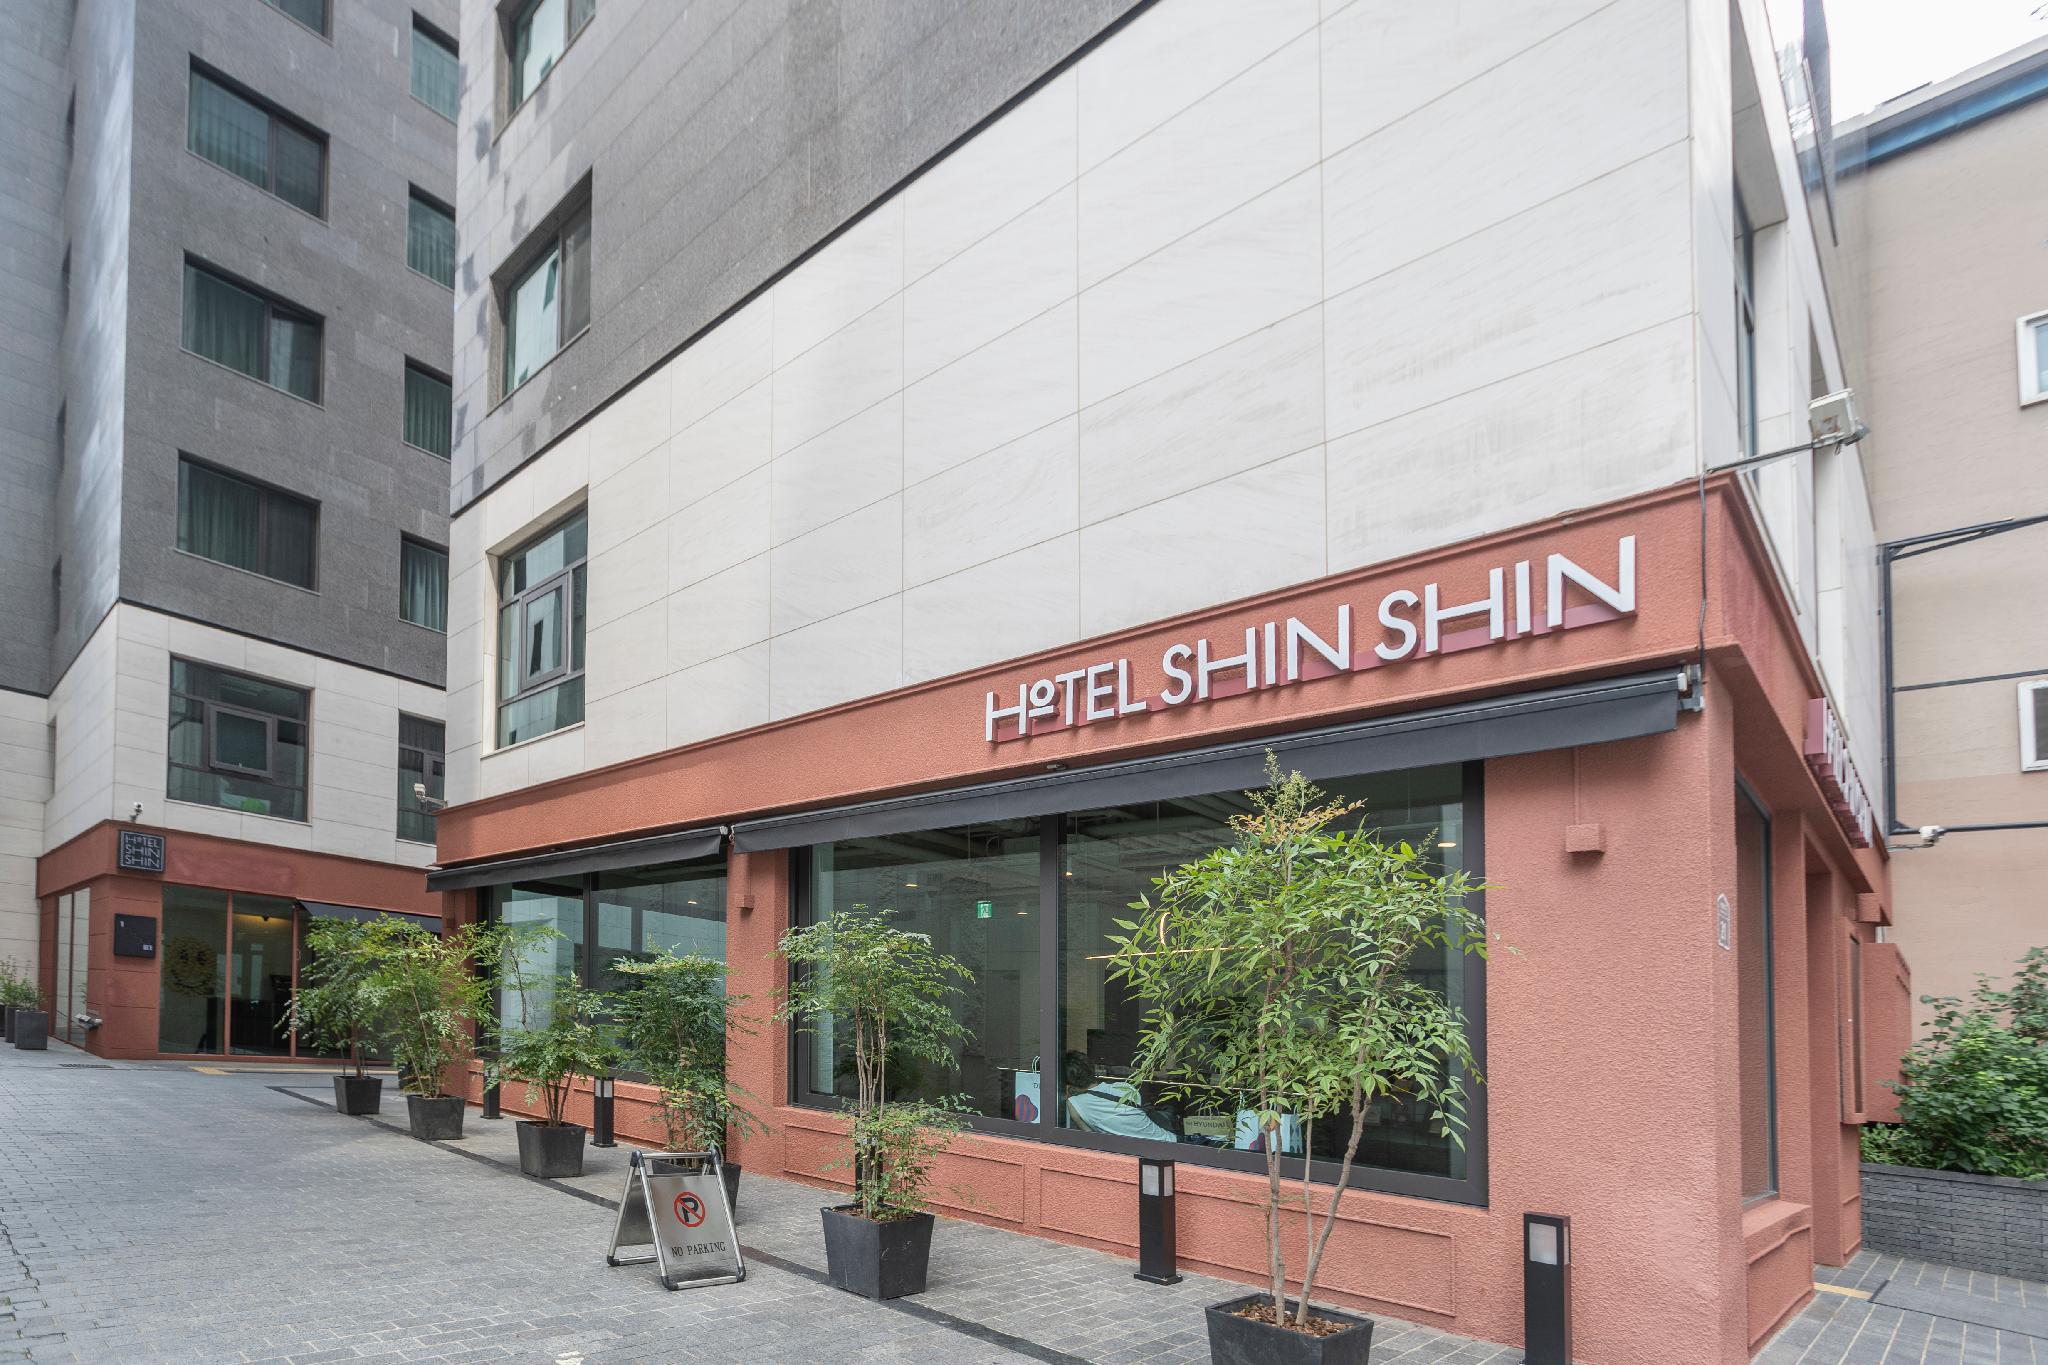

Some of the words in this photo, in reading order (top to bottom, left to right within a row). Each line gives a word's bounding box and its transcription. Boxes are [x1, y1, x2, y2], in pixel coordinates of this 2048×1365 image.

[1160, 604, 1350, 705] SHIN
[1374, 535, 1636, 660] SHIN
[125, 844, 161, 858] SHIN
[125, 854, 160, 868] SHIN
[671, 1246, 684, 1258] NO
[687, 1241, 726, 1256] PARKING
